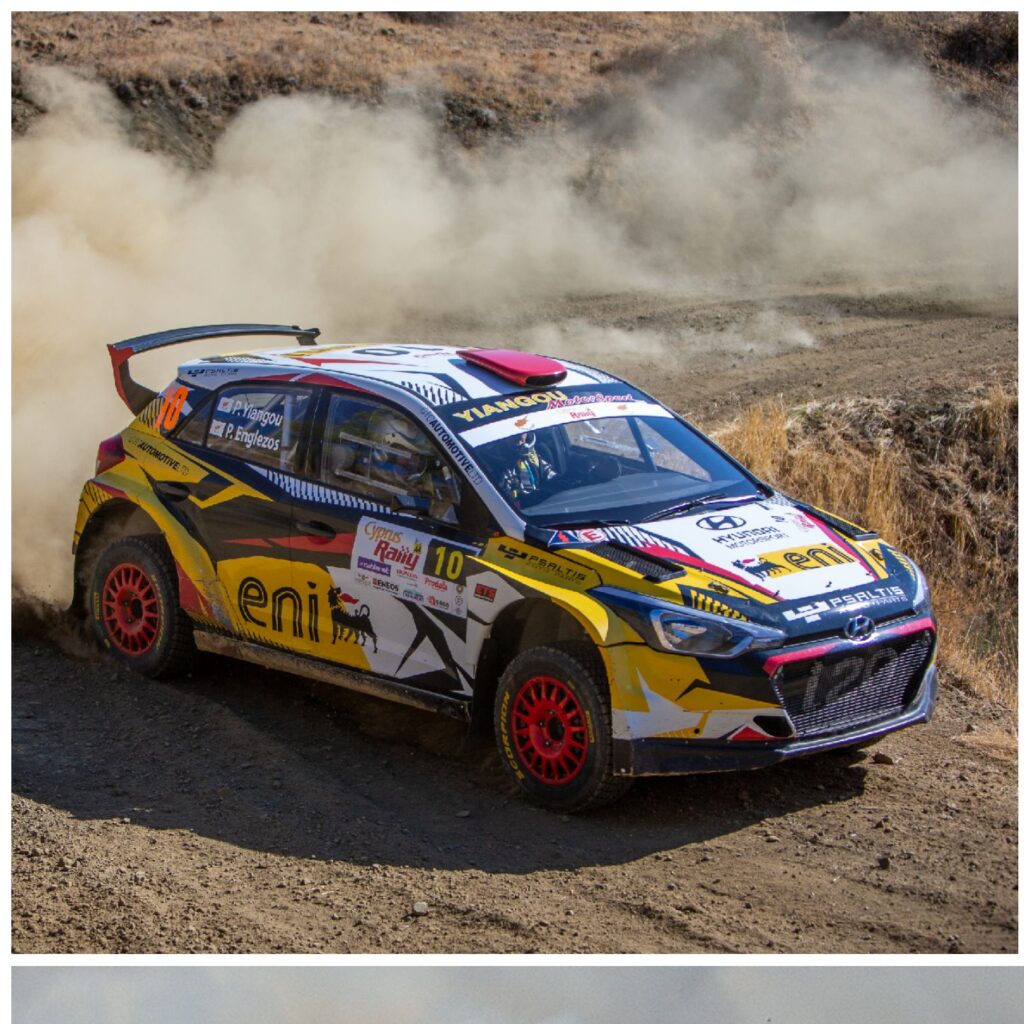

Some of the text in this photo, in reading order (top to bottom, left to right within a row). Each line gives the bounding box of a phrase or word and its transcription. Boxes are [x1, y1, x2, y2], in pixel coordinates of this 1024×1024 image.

[154, 385, 189, 431] 10
[232, 400, 284, 427] P. Yiangou
[453, 390, 568, 423] YIANGOU
[226, 424, 281, 451] P. Englezos
[364, 521, 404, 544] Cyprus
[712, 526, 781, 544] HYUNDAI
[373, 539, 420, 571] Rally
[434, 546, 464, 580] 10
[529, 555, 587, 581] PSALTIS
[783, 543, 855, 571] eni
[237, 576, 320, 643] eni
[829, 586, 904, 608] PSALTIS
